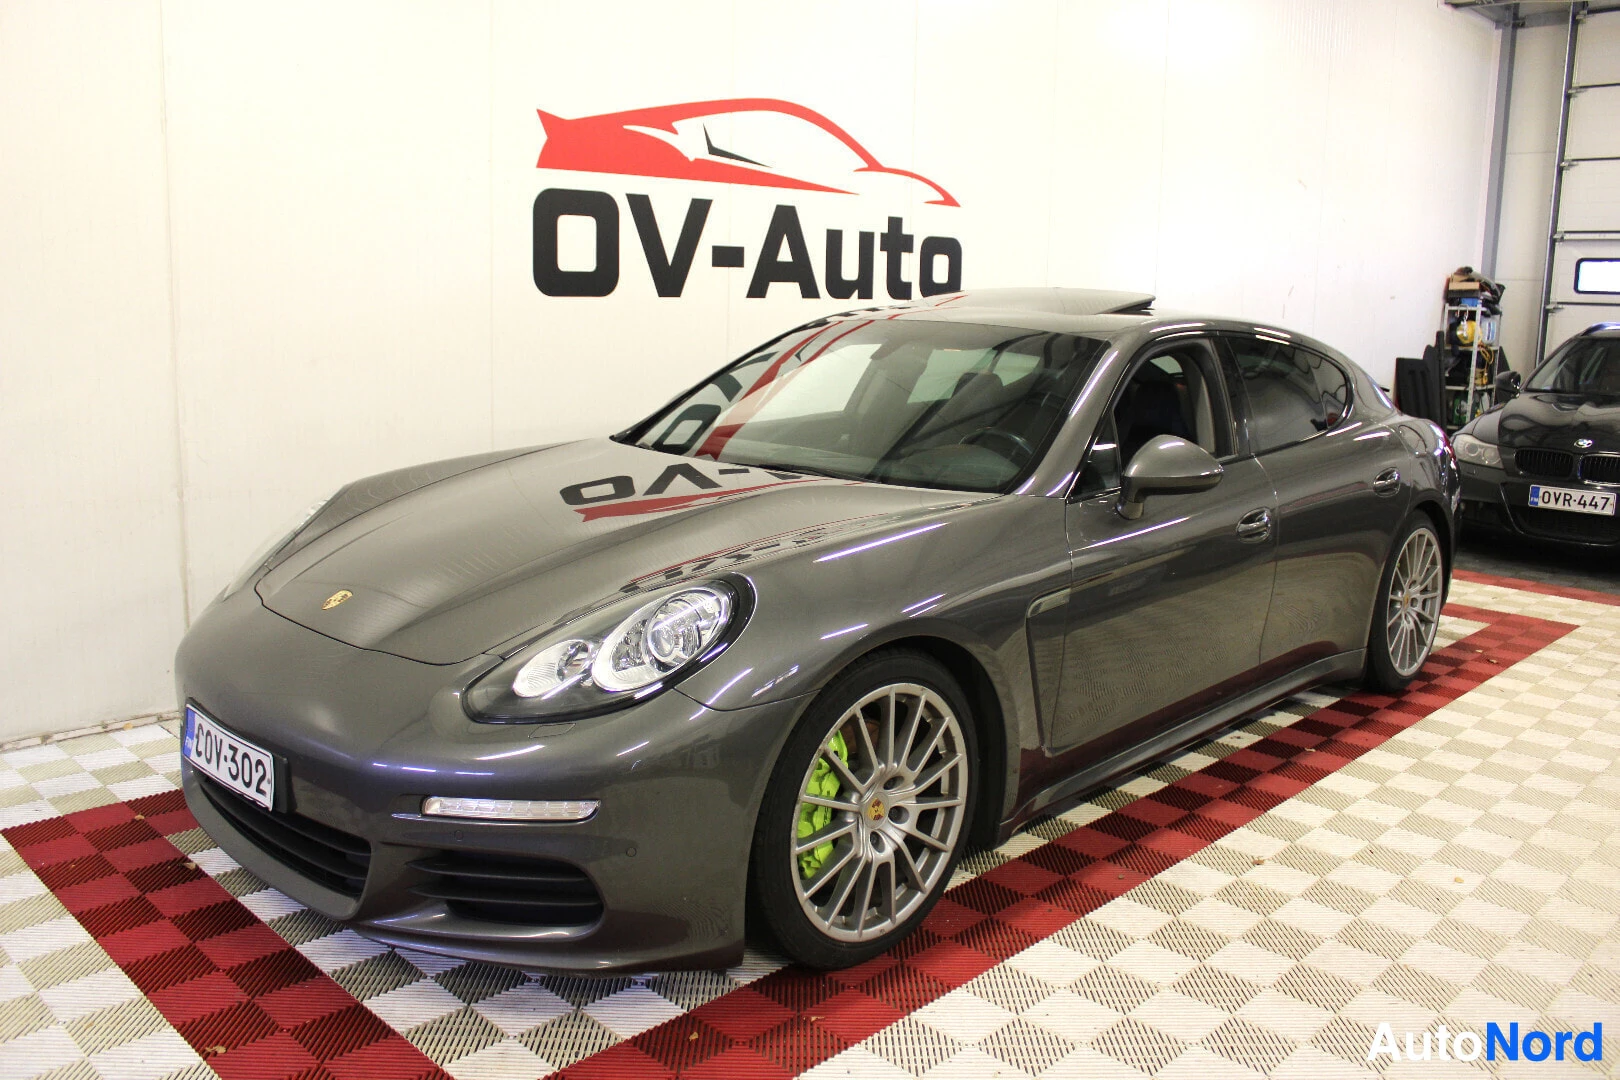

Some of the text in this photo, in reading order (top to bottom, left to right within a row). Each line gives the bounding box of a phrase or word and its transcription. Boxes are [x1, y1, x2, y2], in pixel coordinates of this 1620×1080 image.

[533, 187, 963, 300] OV-Auto
[1542, 491, 1610, 510] OVR-447
[196, 723, 267, 797] COV-302
